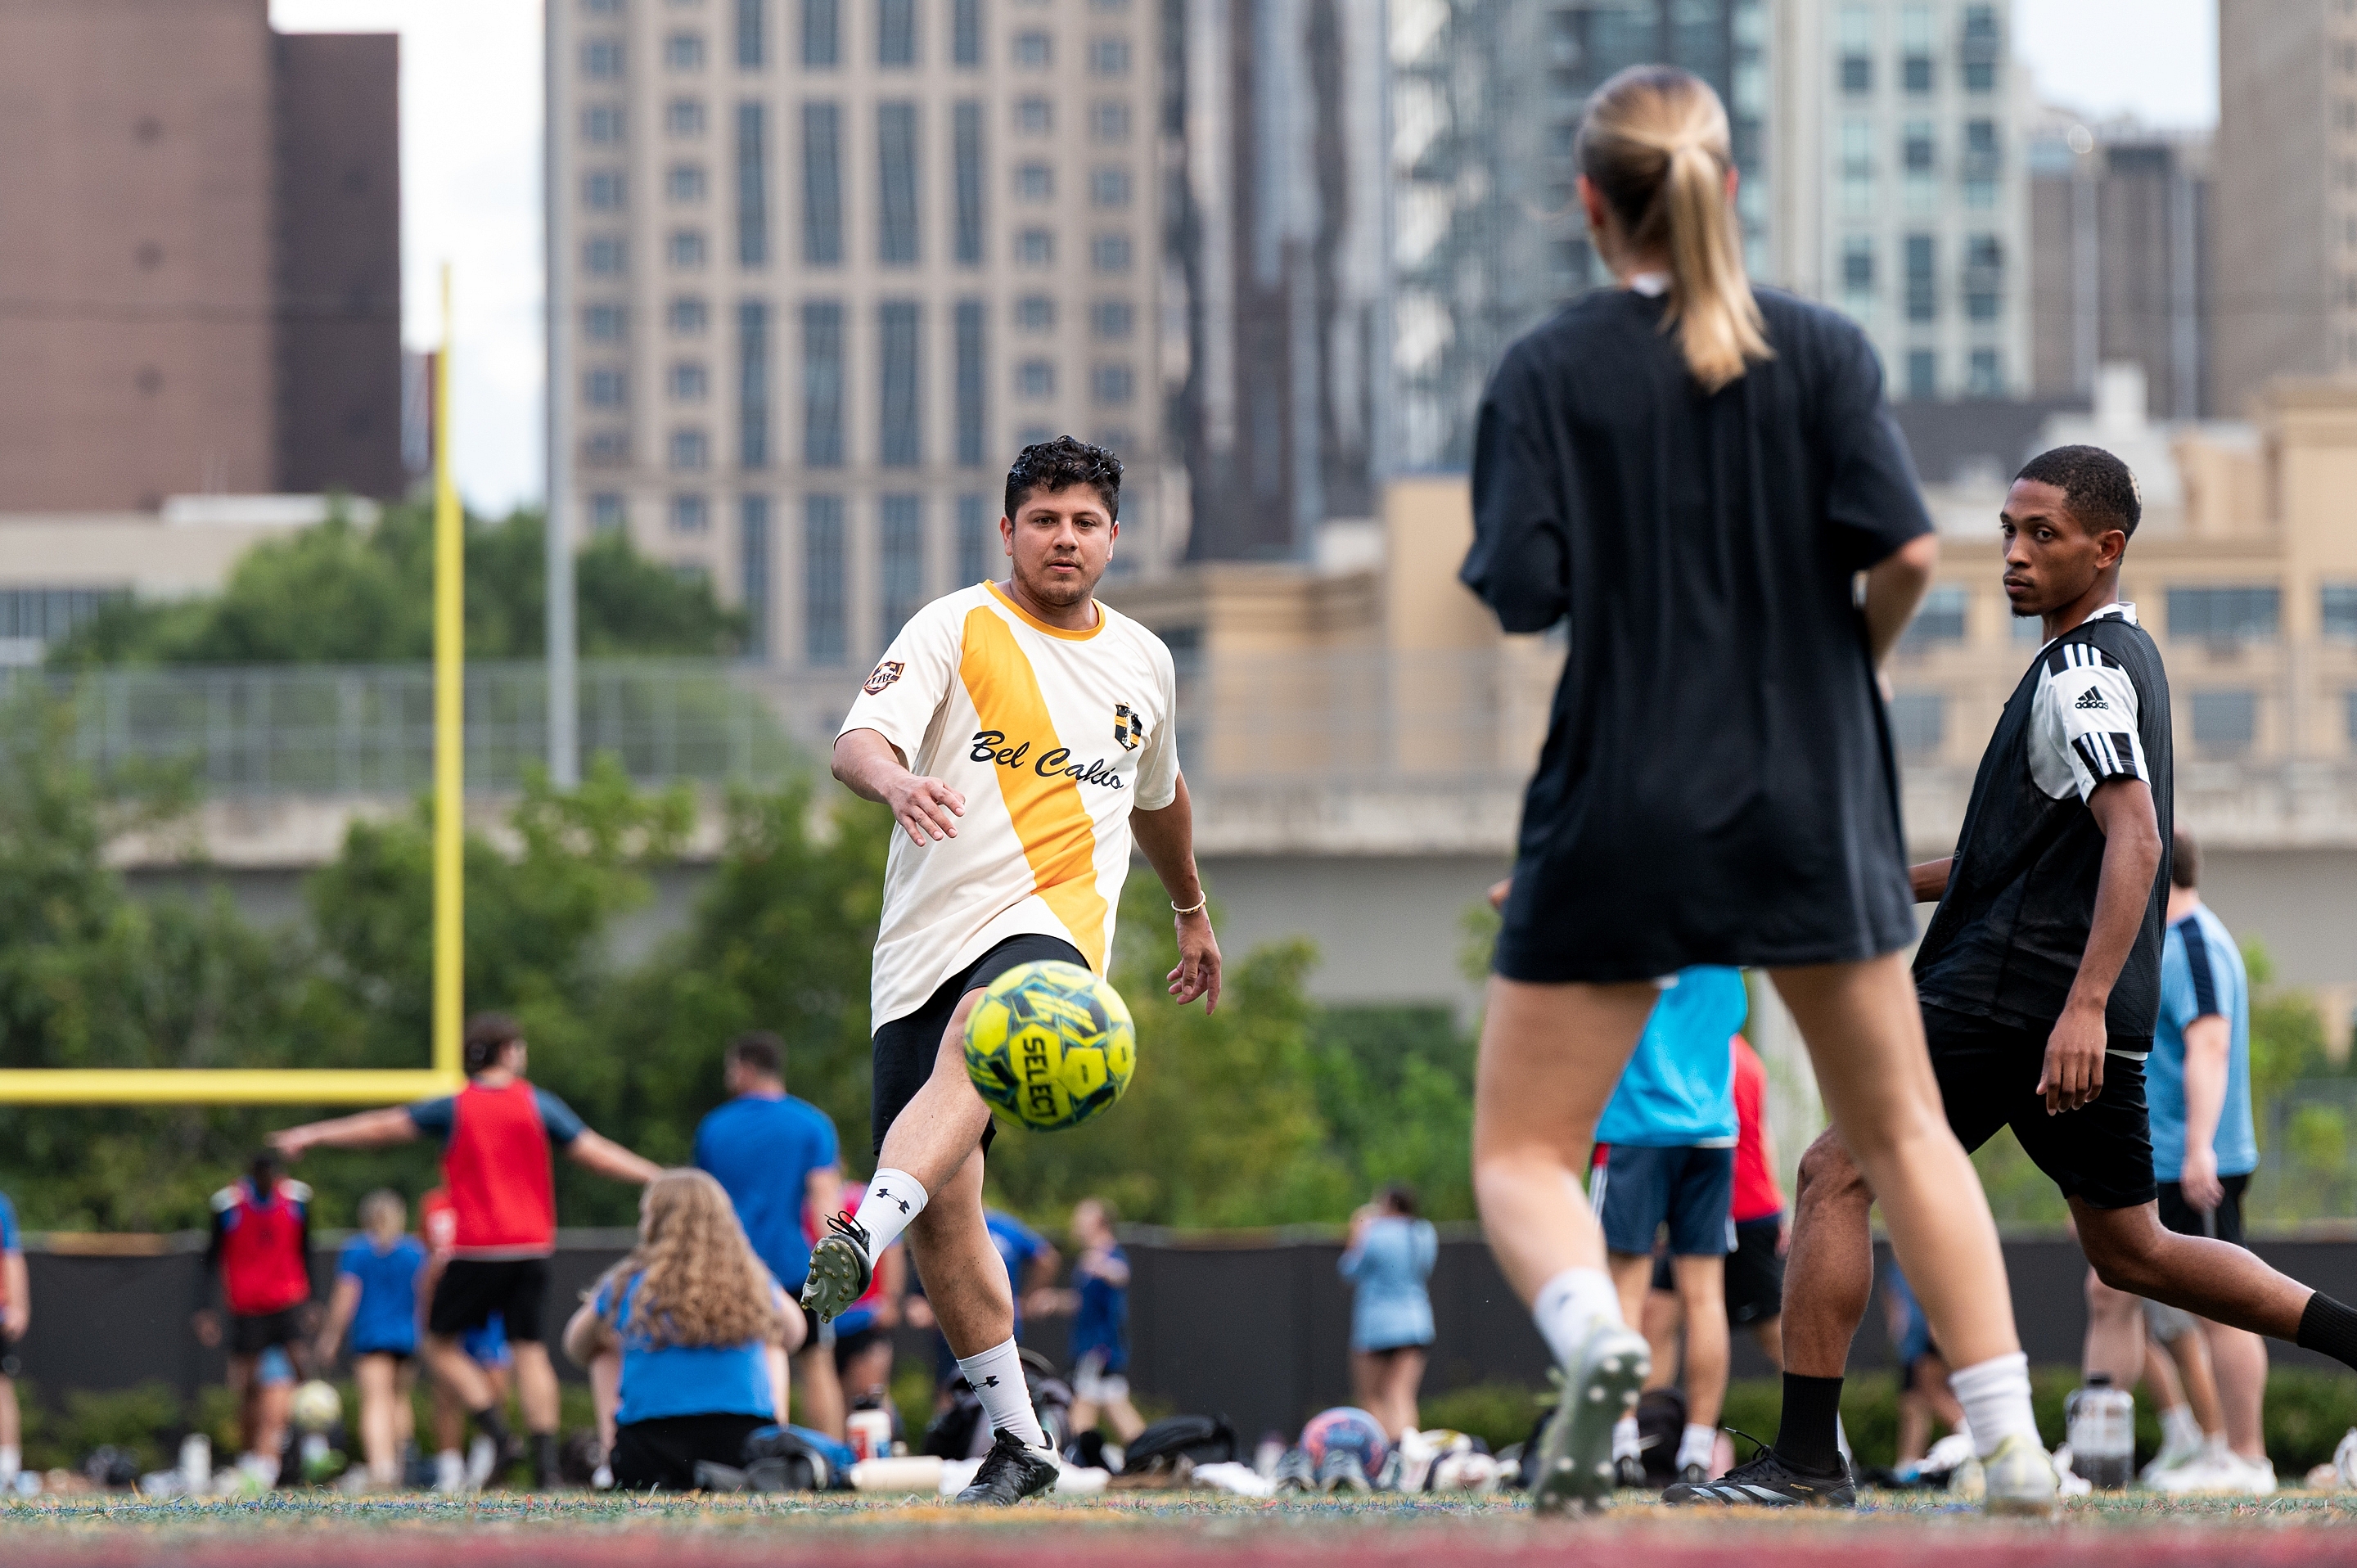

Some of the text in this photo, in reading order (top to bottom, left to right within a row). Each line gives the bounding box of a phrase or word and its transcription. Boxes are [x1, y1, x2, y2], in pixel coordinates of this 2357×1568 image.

[2075, 700, 2109, 710] adidas
[970, 730, 1124, 790] Bel Calcio
[1022, 1037, 1057, 1117] SELECT
